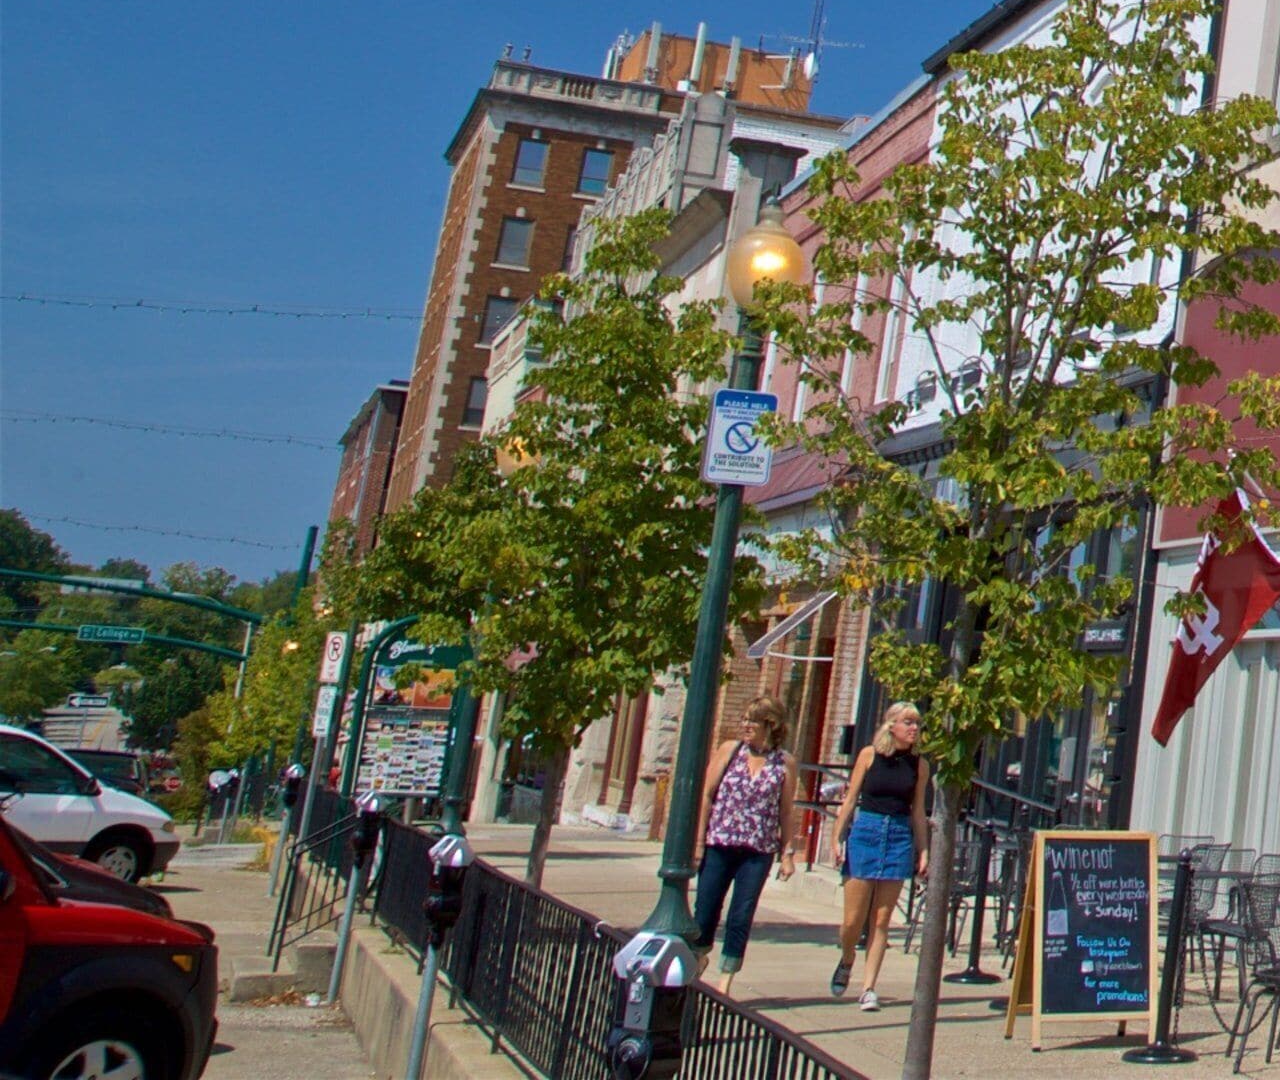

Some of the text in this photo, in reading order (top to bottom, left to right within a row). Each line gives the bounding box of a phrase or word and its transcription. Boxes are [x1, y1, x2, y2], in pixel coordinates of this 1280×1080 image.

[723, 400, 749, 409] PLEASE
[714, 453, 755, 462] CONTRIBUTE
[1083, 873, 1098, 889] off
[1076, 891, 1104, 905] every
